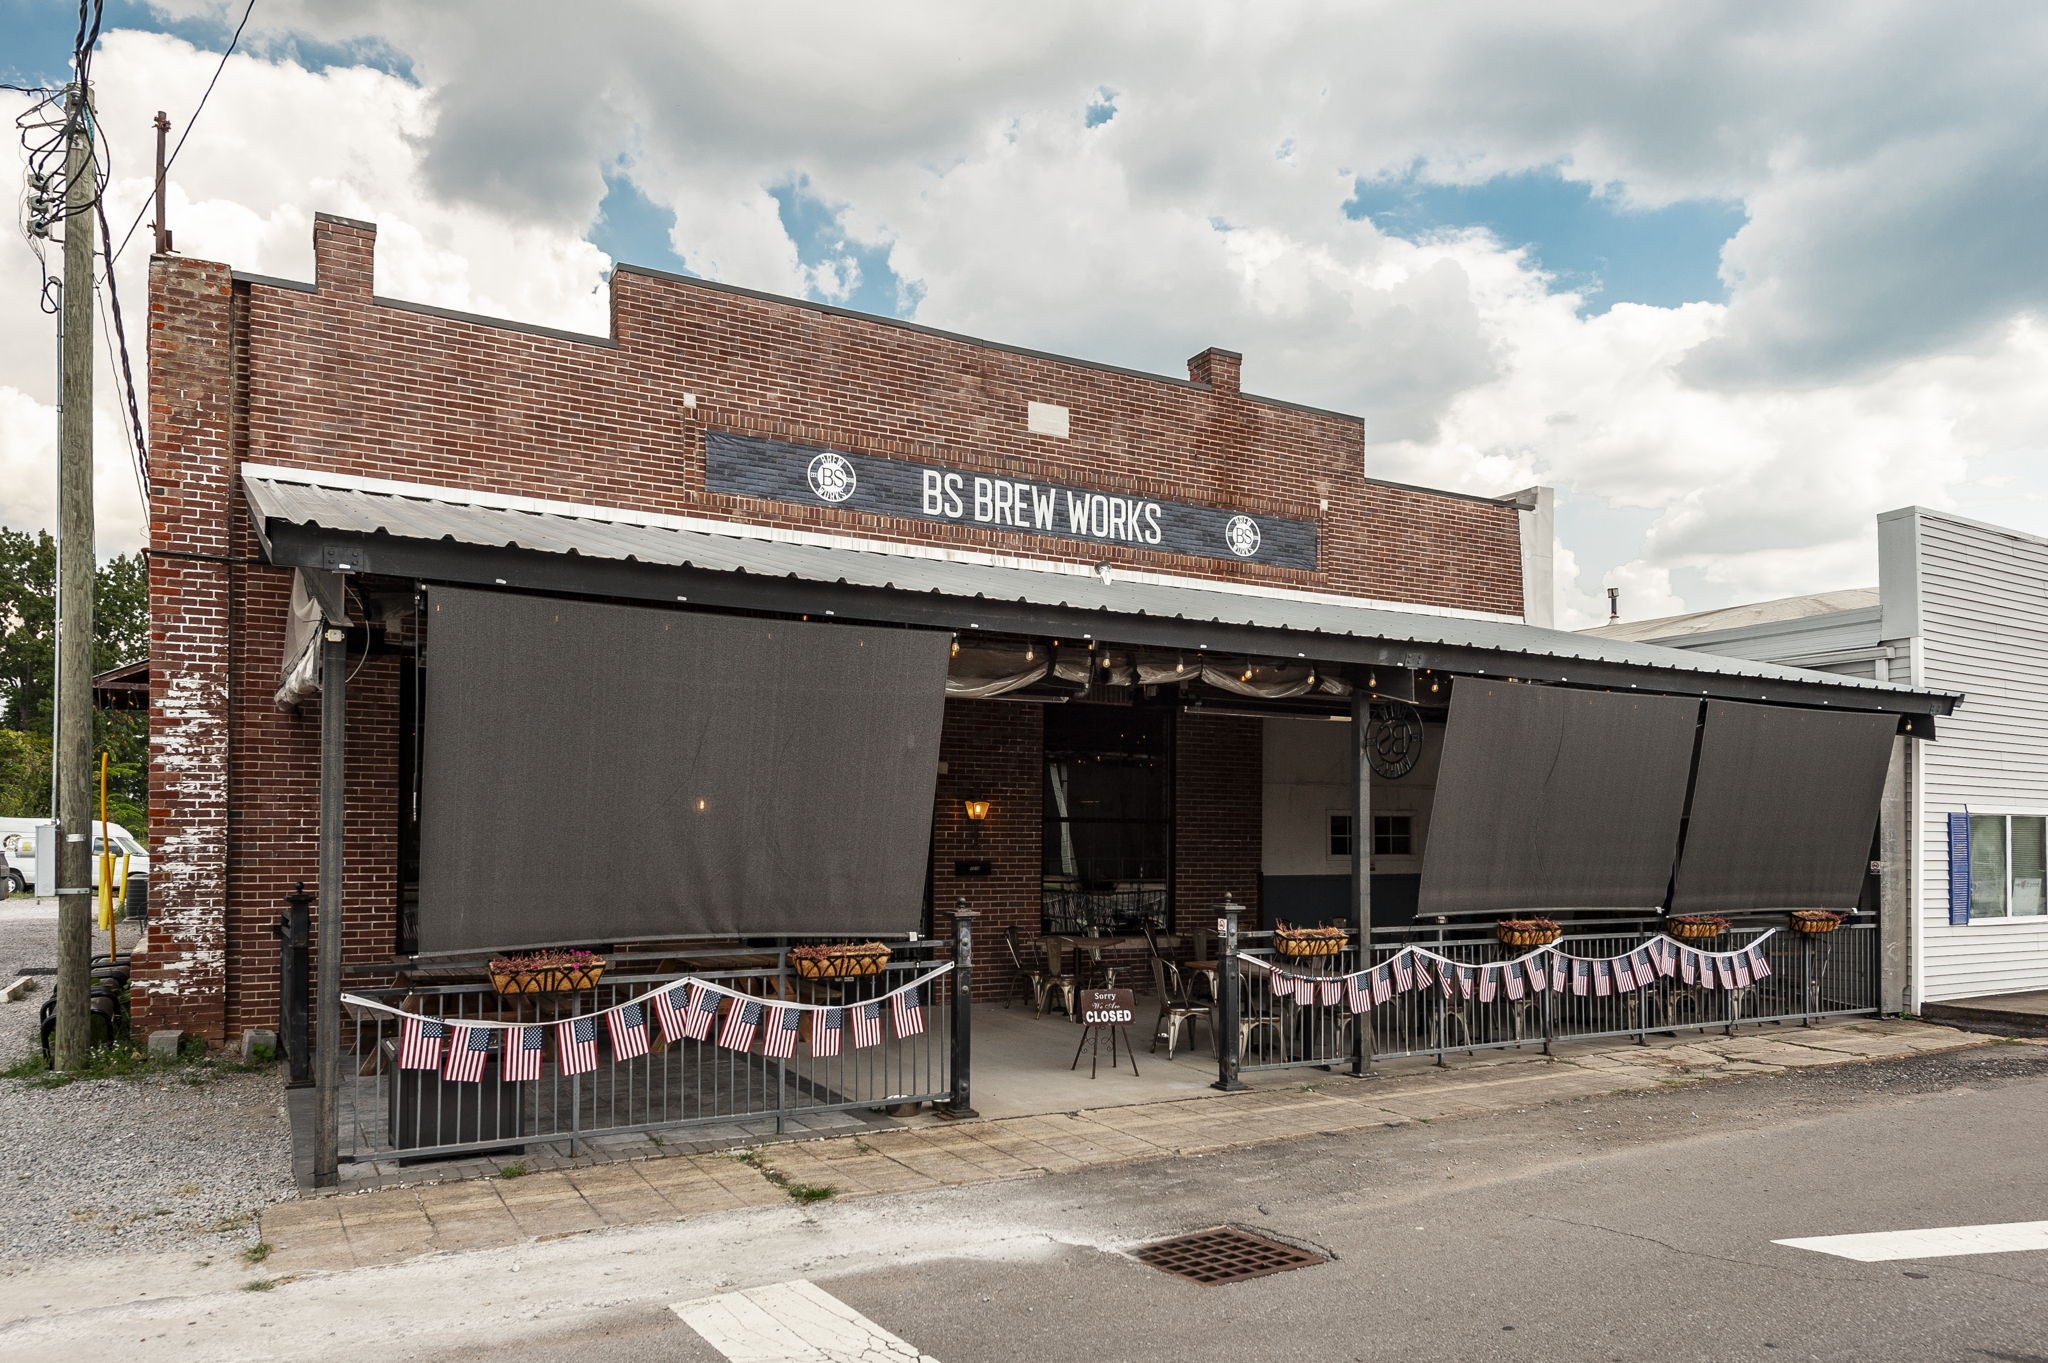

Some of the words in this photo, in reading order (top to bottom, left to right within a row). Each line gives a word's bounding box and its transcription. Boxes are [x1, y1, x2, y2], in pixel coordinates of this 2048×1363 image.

[820, 455, 845, 467] BREW
[821, 467, 845, 488] BS
[817, 486, 847, 500] WORKS
[923, 469, 963, 518] BS
[974, 476, 1056, 531] BREW
[1066, 490, 1162, 544] WORKS
[1236, 527, 1252, 544] BS
[1094, 992, 1116, 1001] Sorry
[1104, 1001, 1120, 1009] Are
[1086, 1010, 1131, 1023] CLOSED
